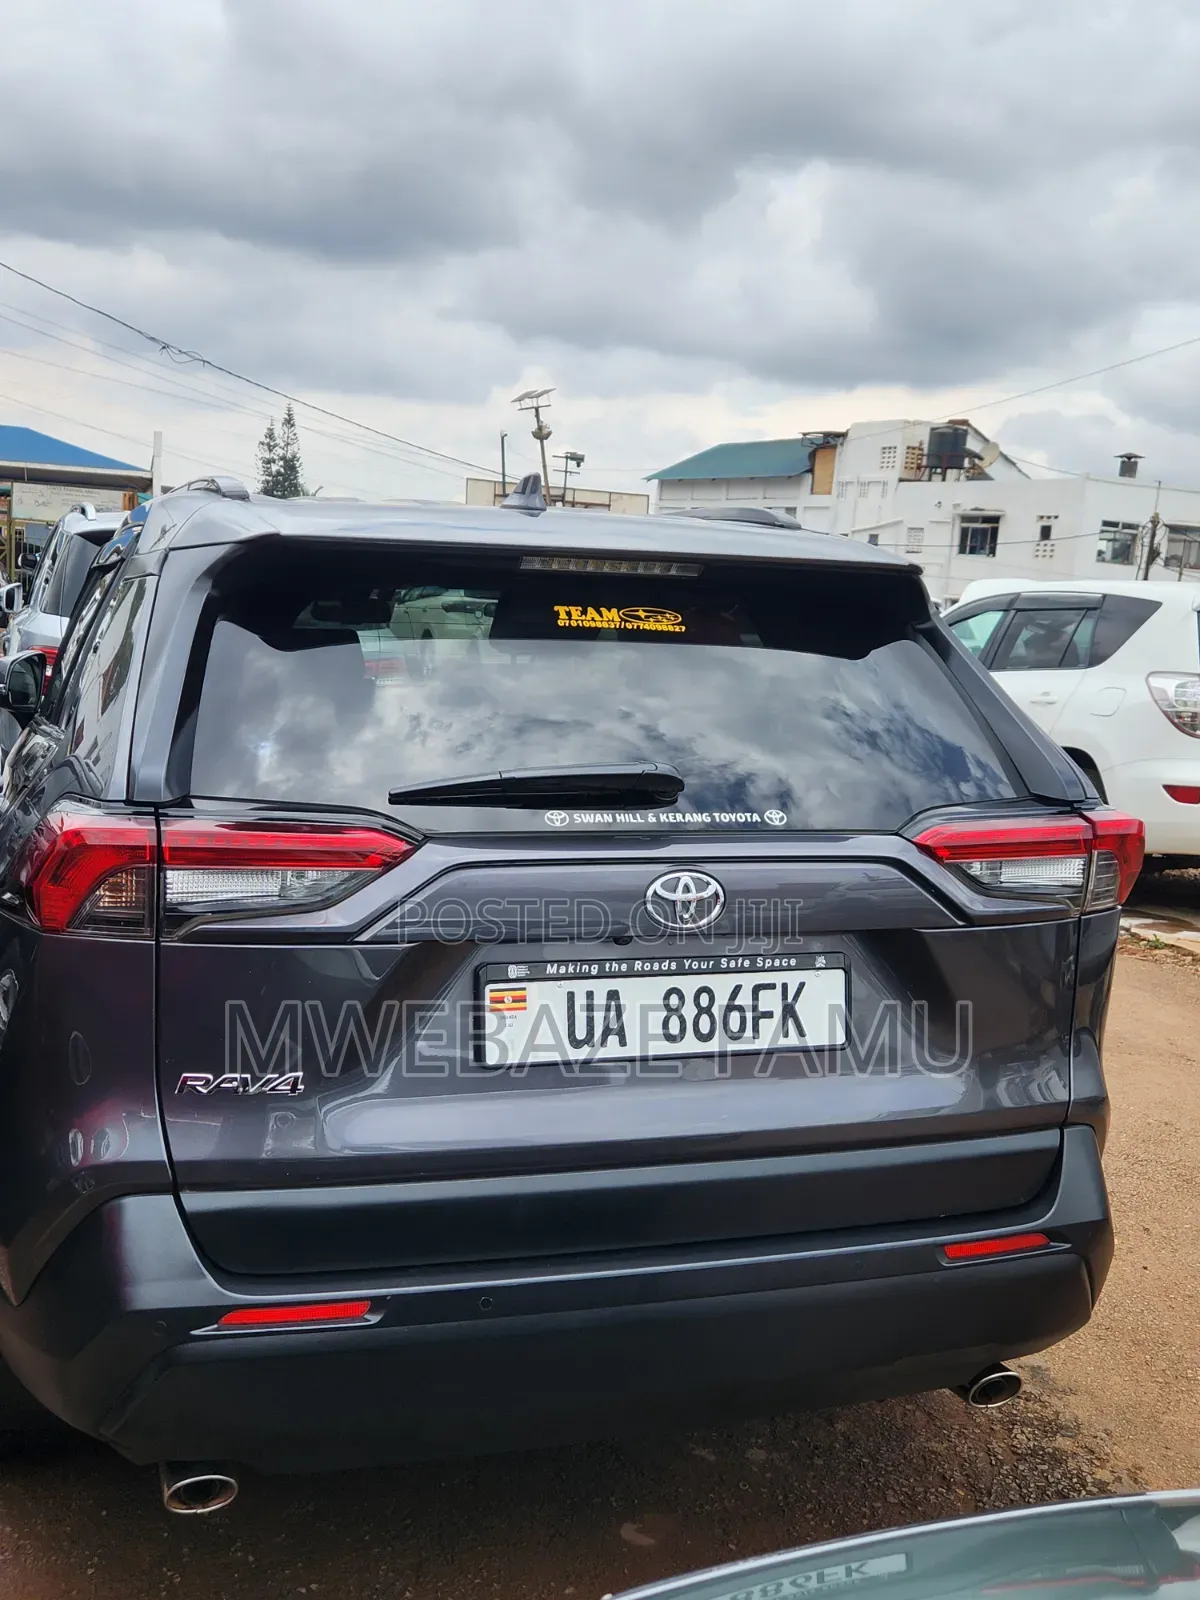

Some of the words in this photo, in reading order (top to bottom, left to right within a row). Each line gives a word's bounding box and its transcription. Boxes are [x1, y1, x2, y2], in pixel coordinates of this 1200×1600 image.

[554, 605, 621, 622] TEAM
[573, 813, 613, 823] SWAN
[615, 812, 645, 823] HILL
[647, 812, 657, 822] &
[660, 812, 711, 823] KERANG
[712, 812, 761, 822] TOYOTA
[546, 963, 599, 976] Making
[604, 962, 628, 973] the
[634, 960, 677, 972] Roads
[684, 959, 715, 970] Your
[720, 957, 751, 969] Safe
[756, 957, 797, 968] Space
[566, 988, 628, 1050] UA
[661, 981, 808, 1043] 886FK
[174, 1071, 305, 1096] RAV4
